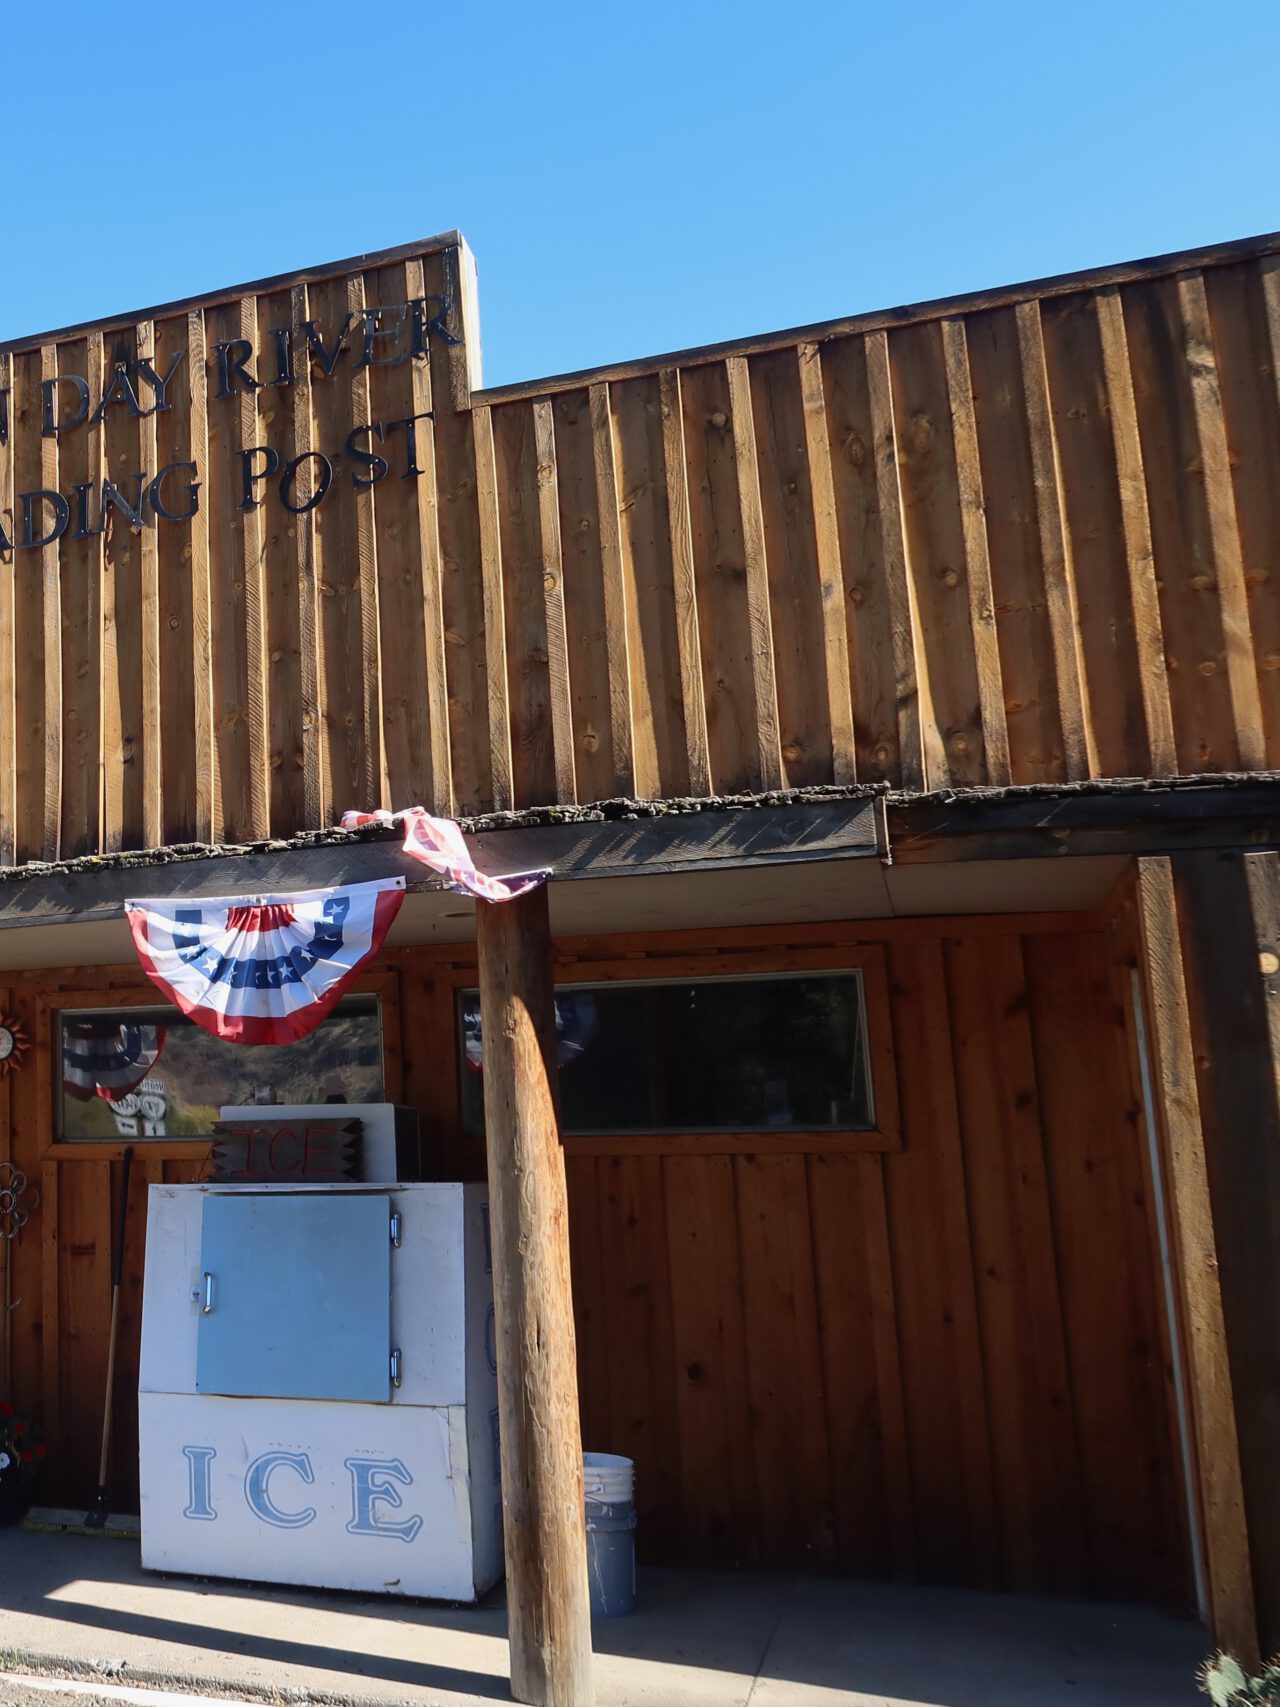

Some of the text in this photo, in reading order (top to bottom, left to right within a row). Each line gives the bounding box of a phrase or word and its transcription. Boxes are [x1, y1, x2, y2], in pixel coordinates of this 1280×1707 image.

[40, 350, 186, 438] DAY
[210, 295, 464, 398] RIVER
[236, 410, 436, 514] POST
[230, 1127, 338, 1177] ICE
[182, 1445, 424, 1543] ICE
